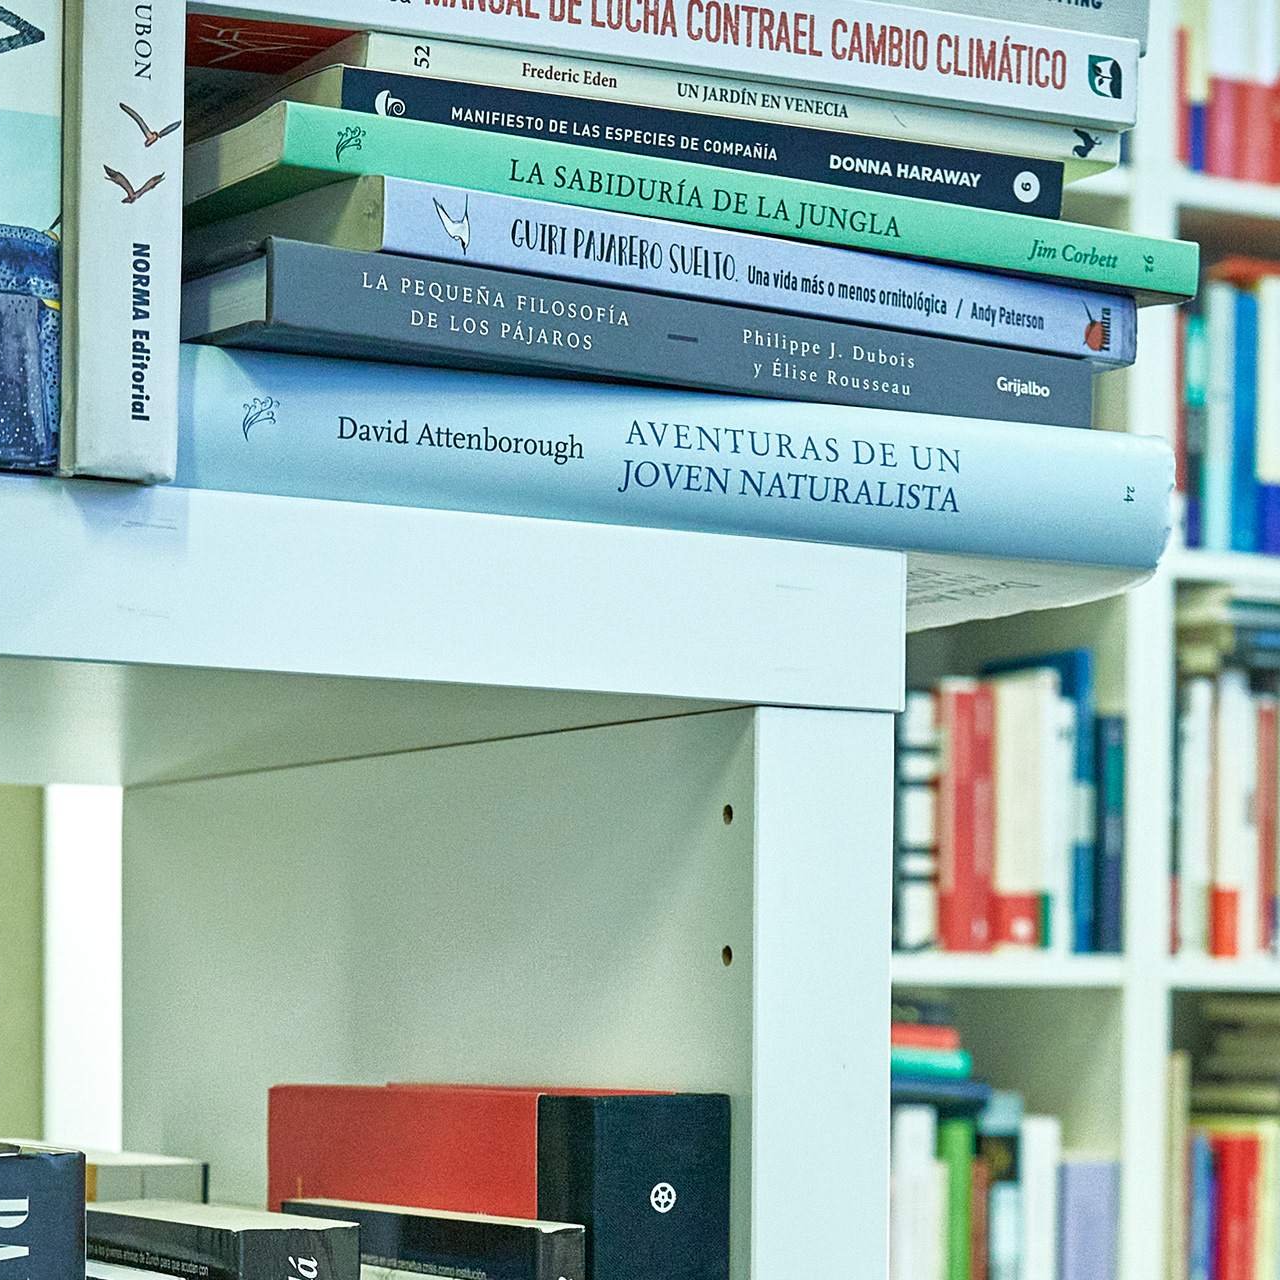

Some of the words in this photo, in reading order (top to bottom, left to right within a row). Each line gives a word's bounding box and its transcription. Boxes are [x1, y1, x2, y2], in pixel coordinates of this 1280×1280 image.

[414, 46, 430, 68] 52
[591, 0, 677, 37] LUCHA
[687, 0, 823, 56] CONTRAEL
[832, 19, 928, 70] CAMBIO
[937, 34, 1066, 90] CLIMÁTICO
[523, 63, 579, 83] Frederic
[584, 71, 617, 88] Eden
[678, 83, 699, 98] UN
[703, 86, 757, 105] JARDÍN
[762, 94, 781, 108] EN
[783, 97, 850, 119] VENECIA
[451, 107, 543, 132] MANIFIESTO
[549, 120, 567, 134] DE
[573, 123, 600, 137] LAS
[606, 127, 675, 147] ESPECIES
[681, 136, 699, 150] DE
[704, 140, 777, 160] COMPAÑÍA
[830, 155, 892, 176] DONNA
[897, 164, 981, 187] HARAWAY
[509, 159, 544, 185] LA
[554, 166, 703, 209] SABIDURÍA
[712, 190, 747, 215] DE
[756, 196, 790, 221] LA
[795, 202, 901, 238] JUNGLA
[511, 219, 566, 255] GUIRI
[574, 228, 662, 269] PAJARERO
[1027, 240, 1056, 261] Jim
[1062, 240, 1118, 273] Corbett
[133, 243, 150, 320] NORMA
[363, 272, 387, 290] LA
[402, 278, 504, 308] PEQUEÑA
[518, 295, 628, 326] FILOSOFÍA
[411, 310, 437, 328] DE
[451, 316, 488, 335] LOS
[501, 321, 591, 350] PÁJAROS
[971, 302, 996, 327] Andy
[999, 307, 1044, 330] Paterson
[132, 330, 150, 421] Editorial
[997, 377, 1050, 397] Grijalbo
[338, 417, 409, 444] David
[416, 424, 584, 465] Attenborough
[624, 420, 839, 464] AVENTURAS
[853, 441, 897, 467] DE
[911, 446, 959, 473] UN
[617, 460, 730, 494] JOVEN
[739, 468, 959, 513] NATURALISTA
